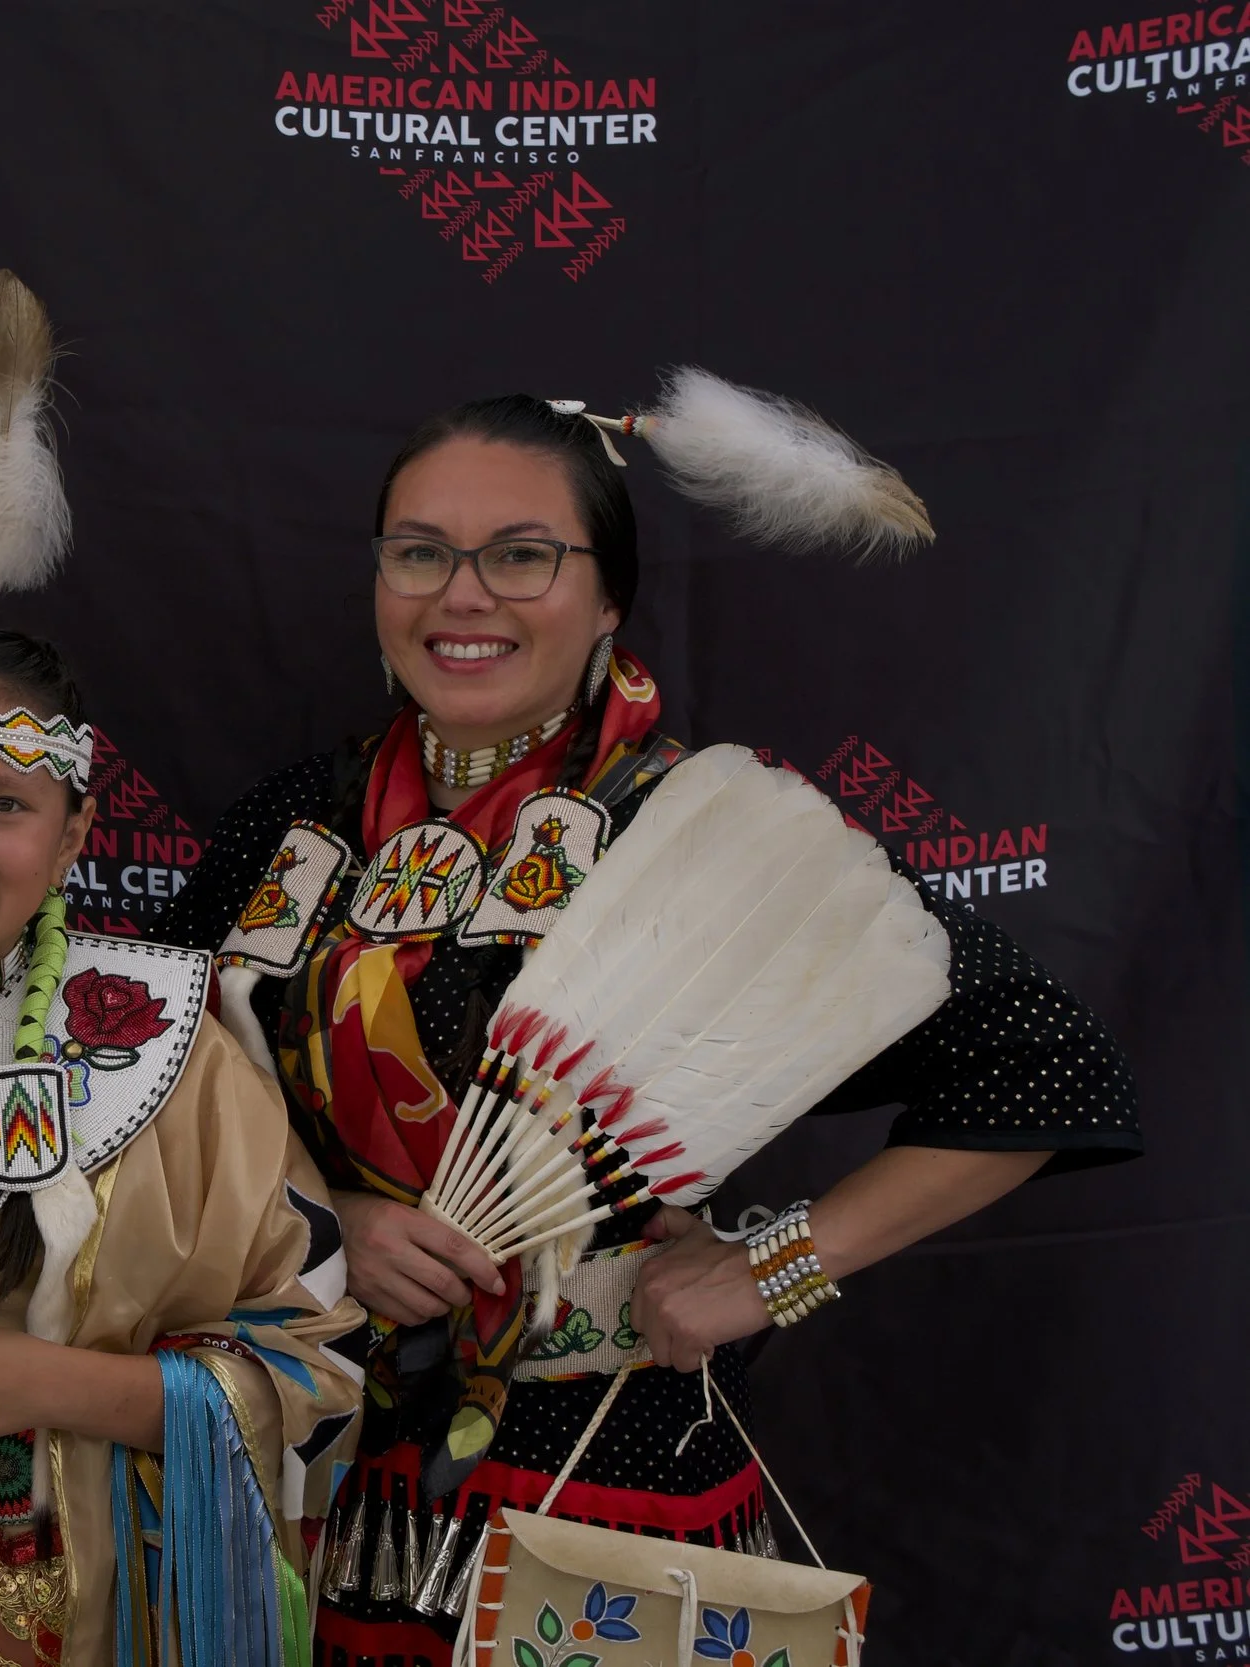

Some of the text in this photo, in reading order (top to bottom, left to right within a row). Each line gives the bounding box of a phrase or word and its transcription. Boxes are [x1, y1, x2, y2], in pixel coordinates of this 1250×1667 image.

[274, 71, 657, 112] AMERICAN INDIAN
[1146, 82, 1200, 104] SAN
[274, 105, 658, 147] CULTURAL CENTER
[132, 831, 212, 867] IND
[905, 823, 1048, 870] INDIAN
[1109, 1575, 1250, 1620] AMERI
[1112, 1610, 1250, 1652] CULTU
[1195, 1644, 1248, 1662] SAN
